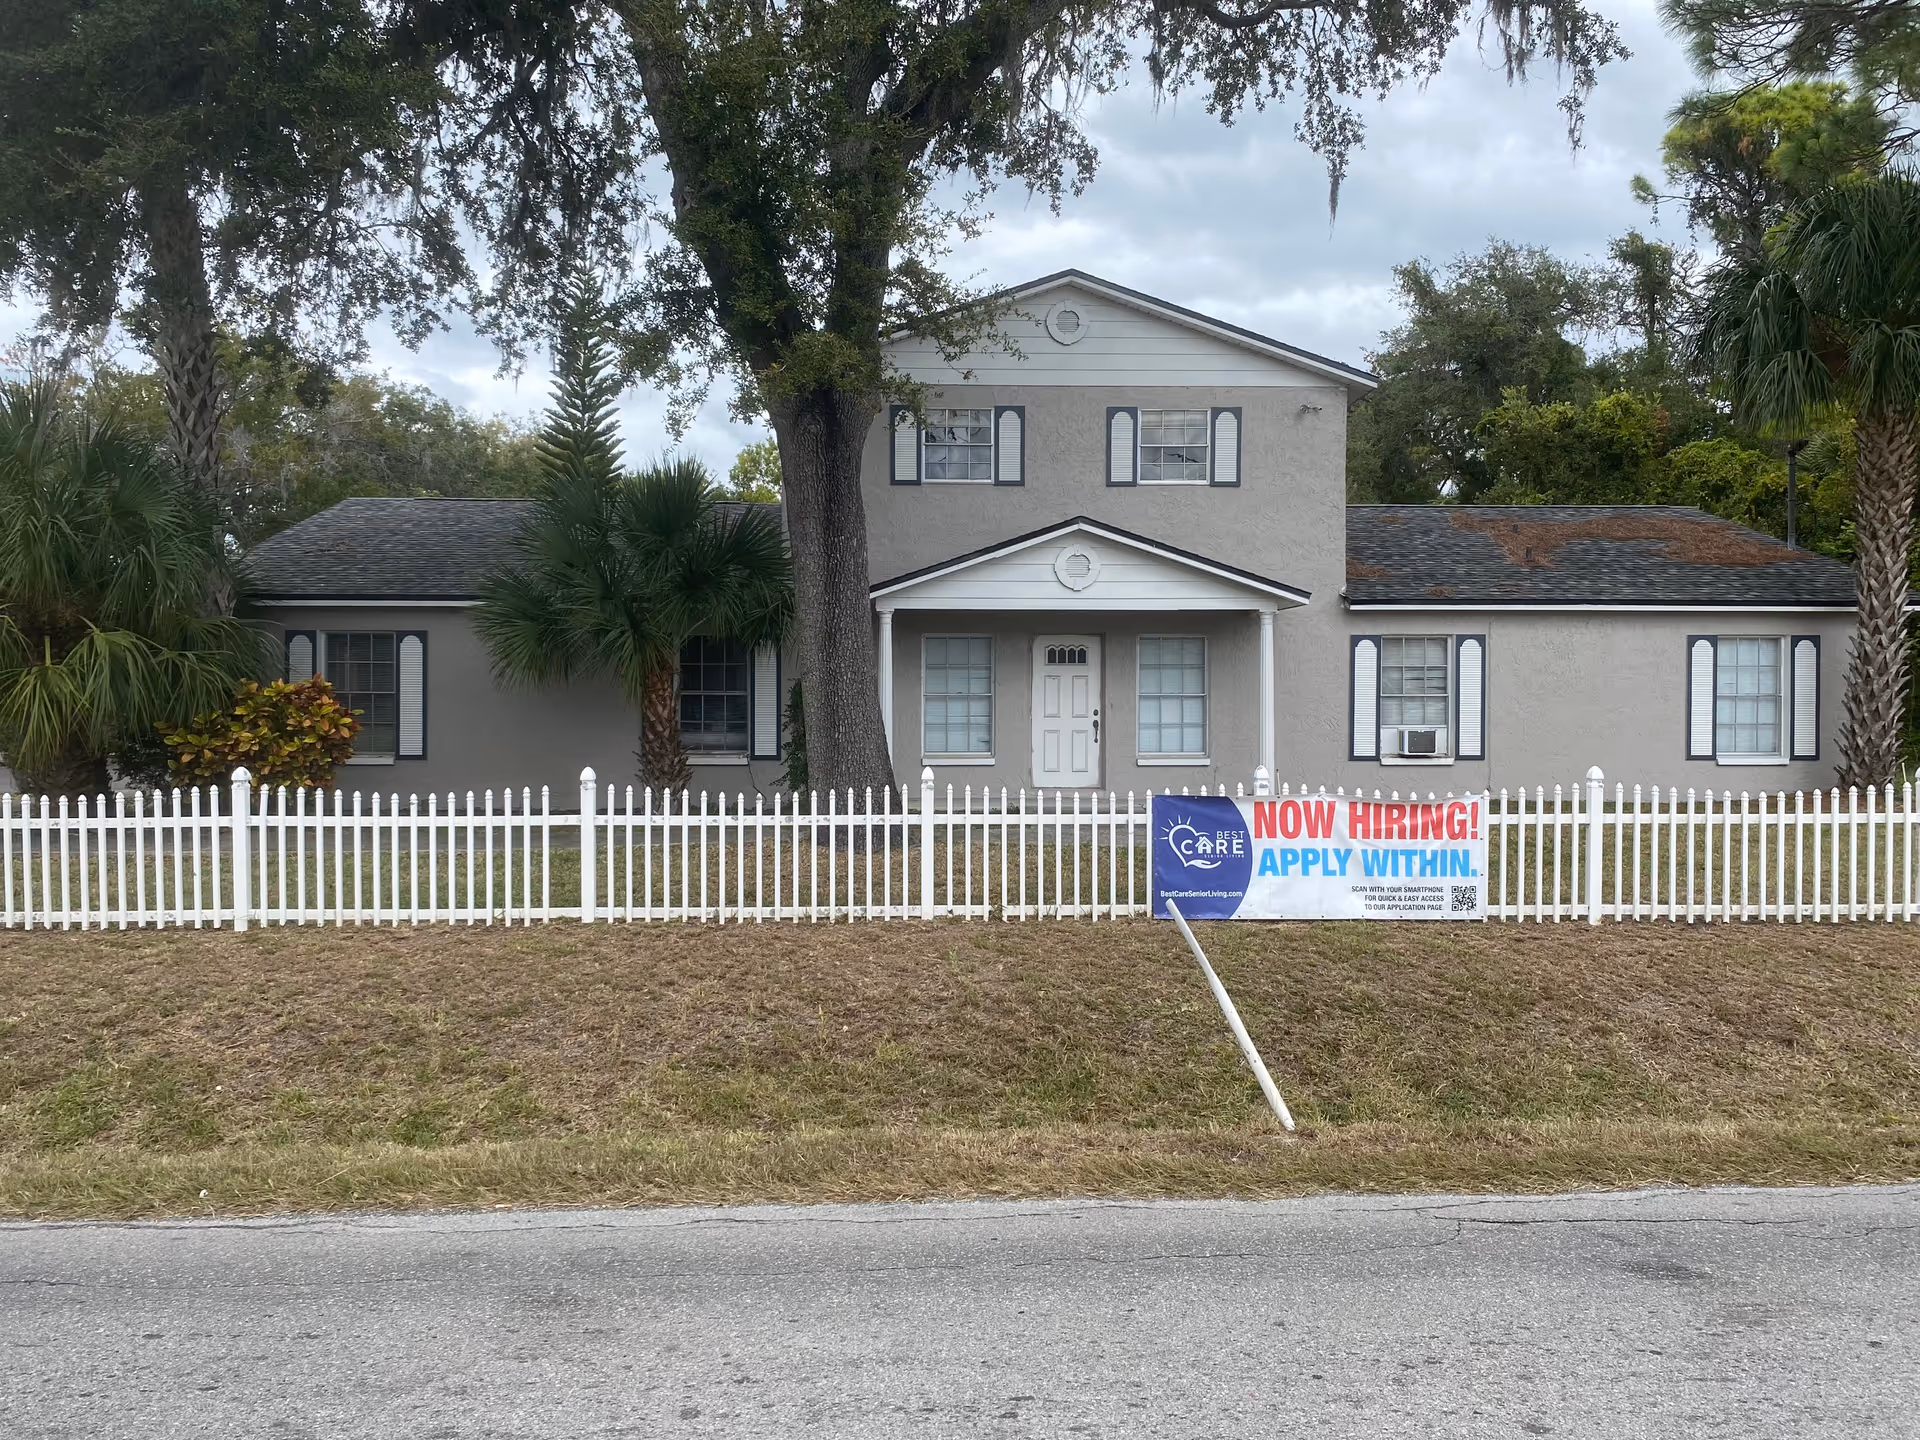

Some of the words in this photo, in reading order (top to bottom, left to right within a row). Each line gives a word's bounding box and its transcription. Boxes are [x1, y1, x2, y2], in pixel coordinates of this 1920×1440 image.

[1254, 800, 1336, 839] NOW
[1348, 802, 1479, 841] HIRING!
[1216, 831, 1244, 839] BEST
[1180, 836, 1244, 854] CARE
[1258, 848, 1350, 876] APPLY
[1362, 849, 1478, 878] WITHIN.
[1160, 890, 1242, 898] BestCareSeniorLiving.com
